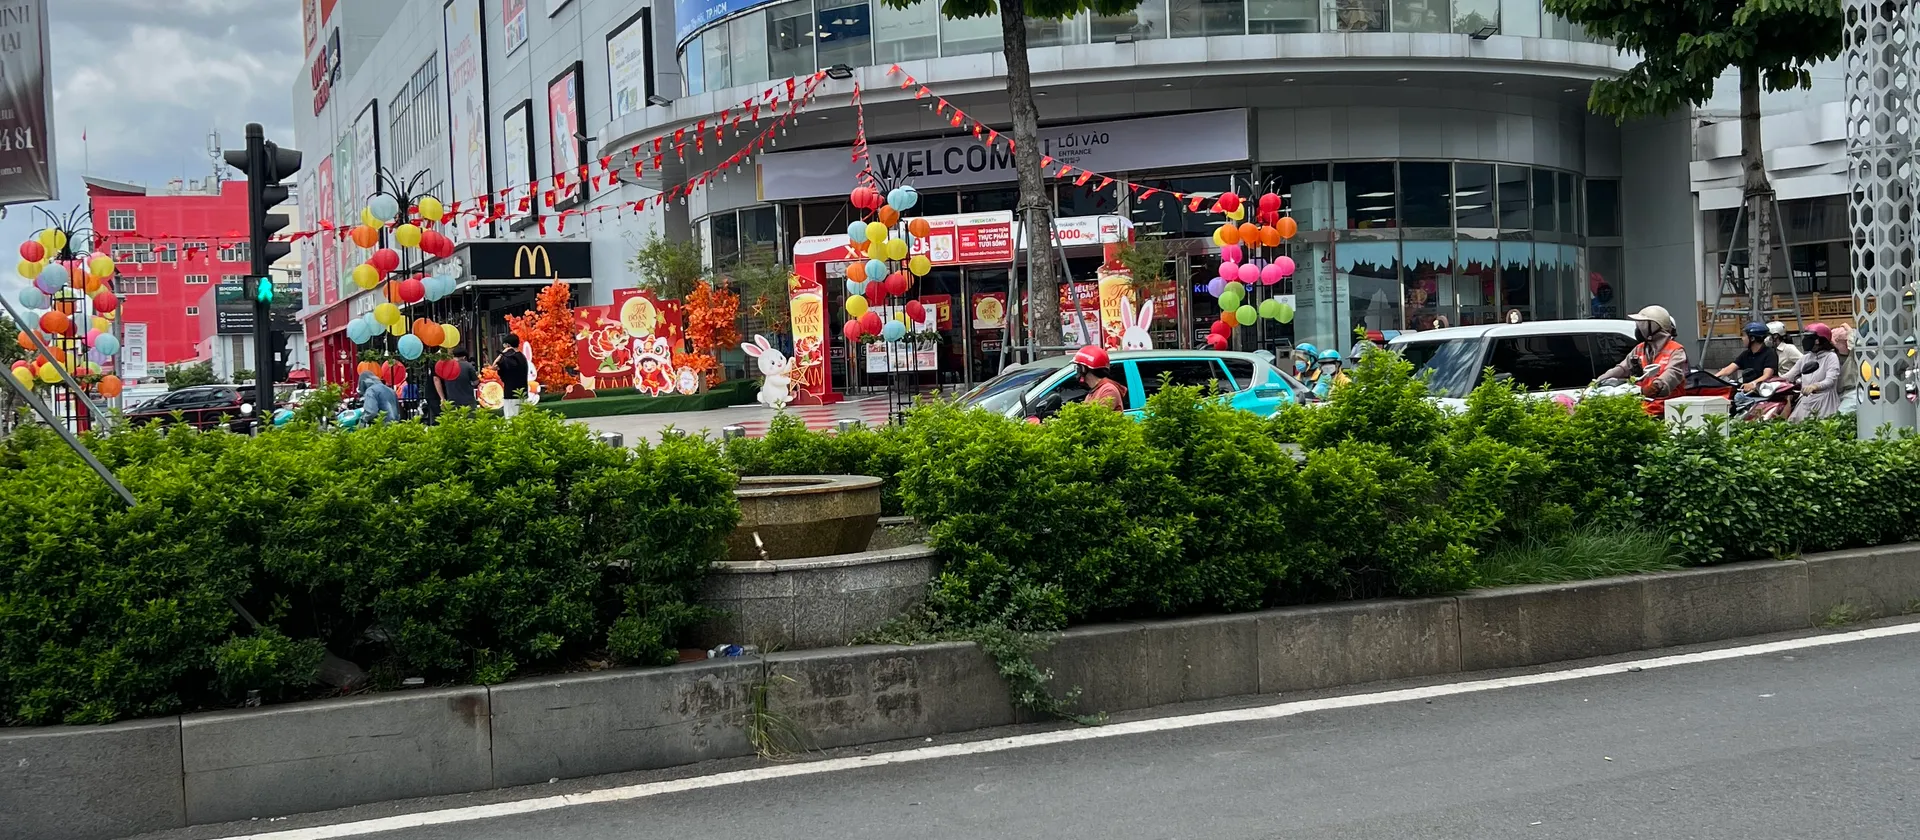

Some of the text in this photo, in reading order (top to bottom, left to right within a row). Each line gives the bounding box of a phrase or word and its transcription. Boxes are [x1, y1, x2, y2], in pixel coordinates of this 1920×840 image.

[705, 2, 727, 20] TP.HCM
[15, 126, 35, 150] 81
[1057, 132, 1110, 148] LỐI VÀO
[1058, 148, 1092, 156] ENTRANCE
[876, 144, 1016, 180] WELCOM
[794, 314, 820, 325] ĐOÀN
[797, 323, 819, 334] VIÊN
